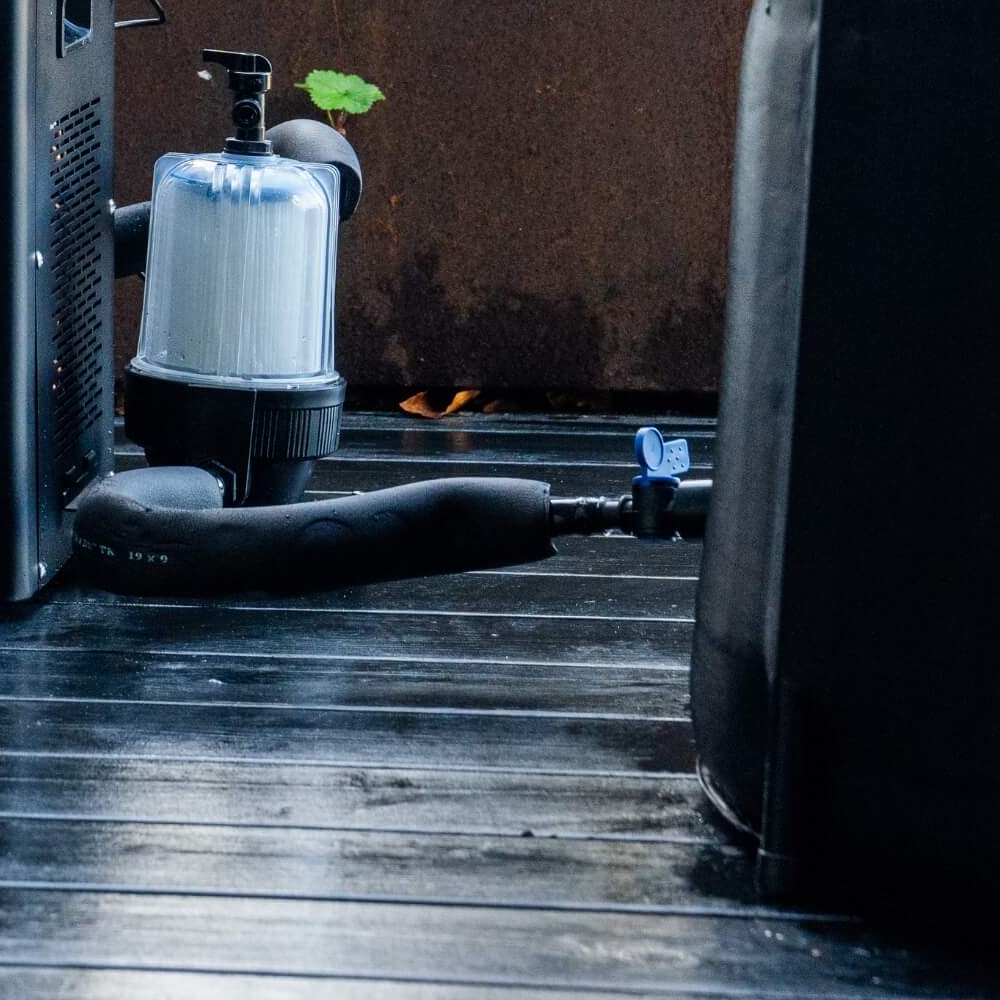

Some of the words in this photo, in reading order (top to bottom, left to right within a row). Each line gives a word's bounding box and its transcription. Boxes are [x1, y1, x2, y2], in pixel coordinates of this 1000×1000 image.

[128, 551, 143, 561] 19
[147, 554, 155, 562] x
[159, 554, 168, 564] 9
